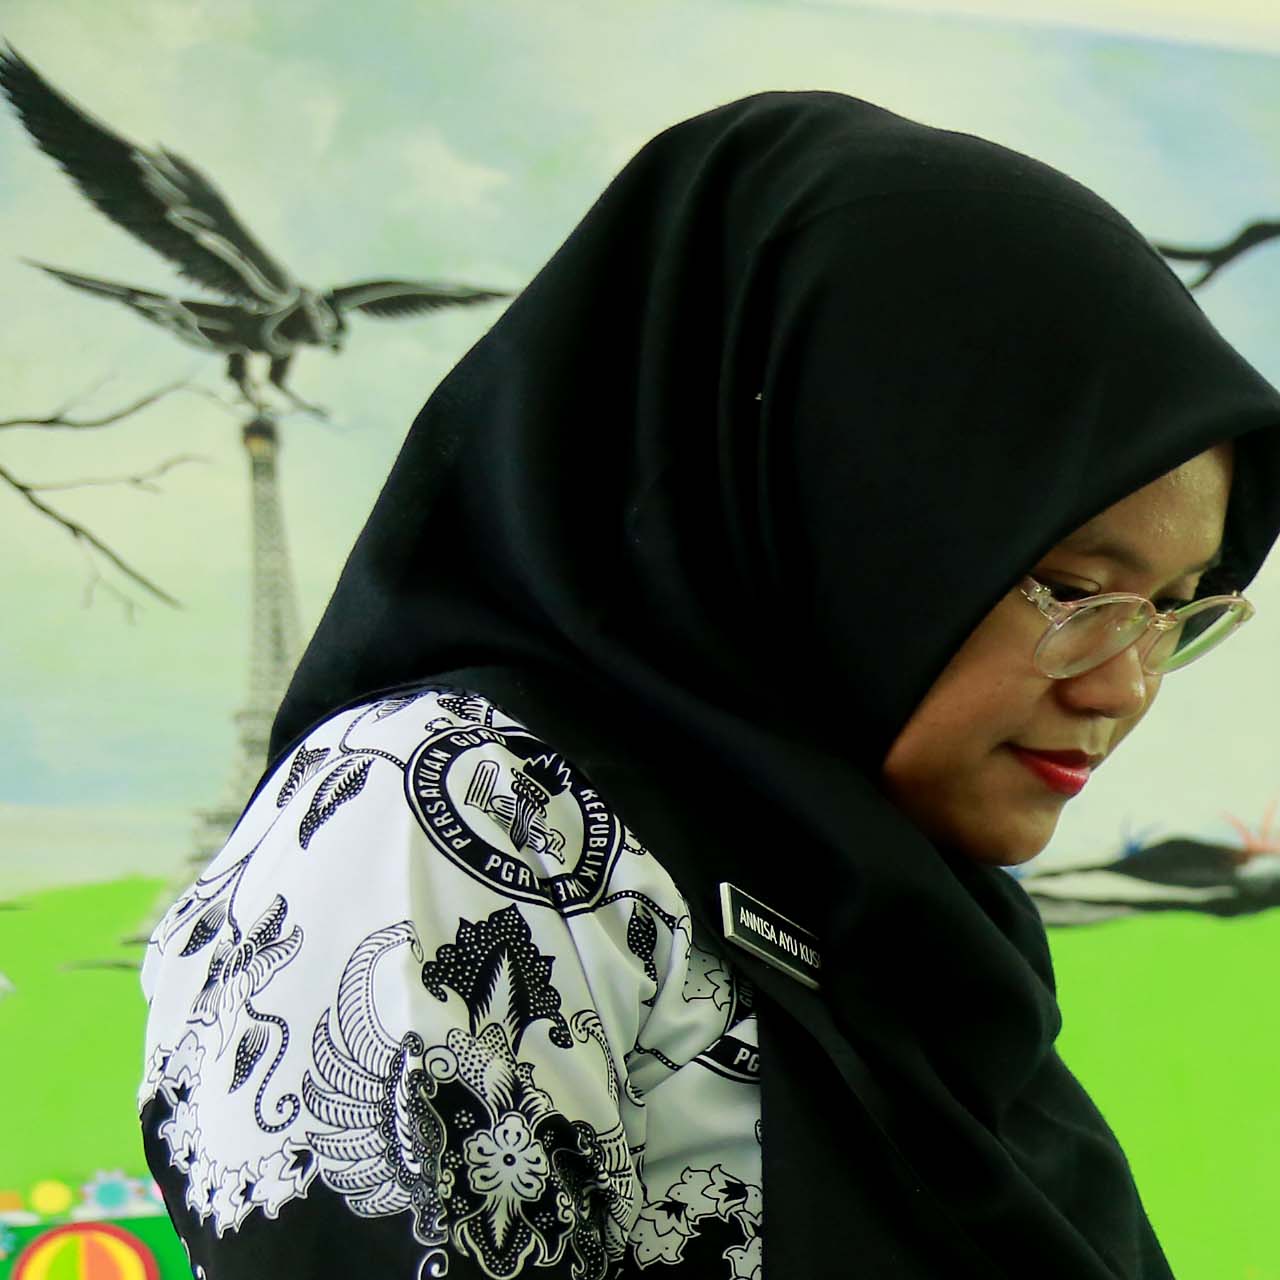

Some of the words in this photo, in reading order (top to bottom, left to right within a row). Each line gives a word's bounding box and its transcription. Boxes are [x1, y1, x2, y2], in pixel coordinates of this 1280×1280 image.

[418, 748, 472, 852] PERSATUAN
[449, 728, 509, 748] GURU
[579, 788, 611, 884] REPUBLIK
[484, 854, 541, 891] PGRI
[739, 905, 778, 945] ANNISA
[778, 929, 799, 957] AYU
[799, 942, 822, 970] KUS
[732, 1047, 761, 1073] PG
